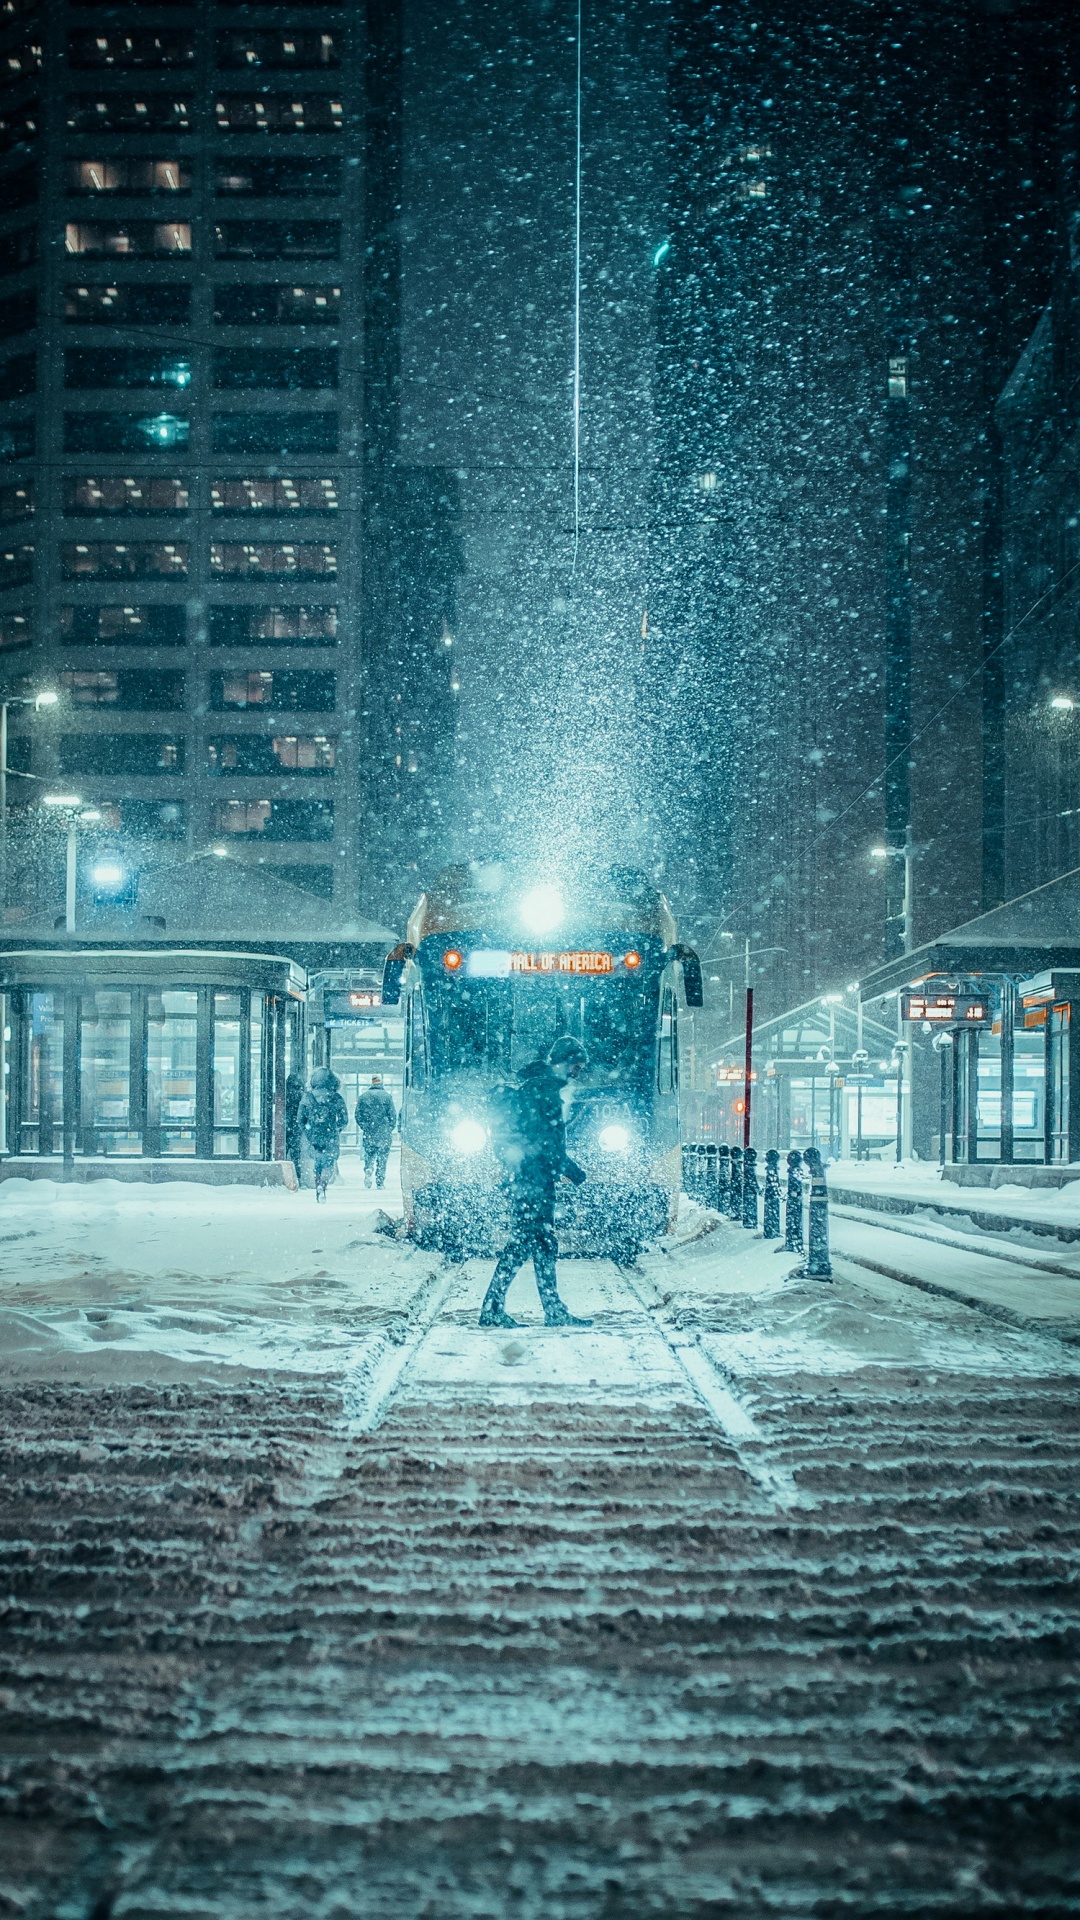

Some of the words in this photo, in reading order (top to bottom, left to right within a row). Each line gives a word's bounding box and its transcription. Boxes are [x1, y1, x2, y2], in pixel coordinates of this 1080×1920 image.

[510, 953, 537, 970] MALL
[541, 953, 556, 970] OF
[559, 953, 611, 971] AMERICA
